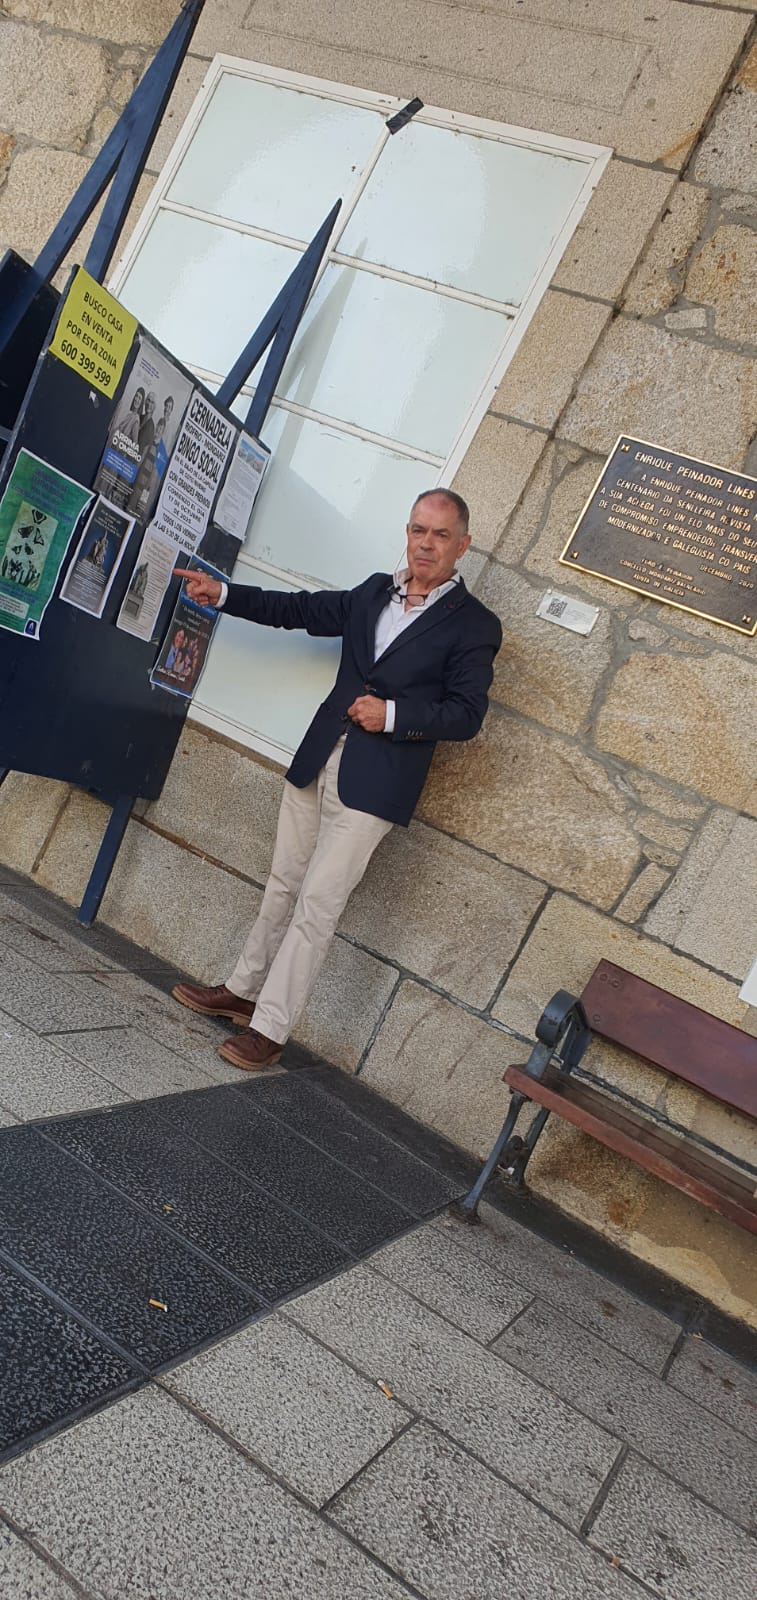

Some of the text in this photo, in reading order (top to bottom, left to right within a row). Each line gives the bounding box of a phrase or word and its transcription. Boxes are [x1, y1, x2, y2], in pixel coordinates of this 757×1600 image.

[82, 311, 113, 345] EN VENTA
[84, 292, 123, 333] BUSCO CASA
[61, 340, 111, 386] 600 399 599
[67, 320, 117, 369] POR ESTA ZONA
[114, 430, 139, 451] ARRIMA
[190, 398, 231, 450] CERNADELA
[119, 442, 141, 462] OMBRO
[178, 433, 200, 464] BINGO
[198, 450, 221, 483] SOCIAL
[168, 486, 190, 506] COMIENZO
[635, 452, 756, 500] ENRIQUE PEINADOR LINES
[599, 500, 608, 509] DE
[612, 503, 659, 526] COMPROMISO
[609, 489, 622, 500] SUA
[659, 505, 670, 517] FOI
[674, 513, 685, 522] UN
[688, 518, 702, 528] ELO
[705, 524, 725, 537] MAIS
[728, 531, 740, 542] DO
[617, 479, 660, 499] CENTENARIO
[664, 495, 673, 504] DA
[677, 500, 716, 519] SENLLEIRA
[651, 477, 682, 494] ENRIQUE
[686, 489, 723, 507] PEINADOR
[727, 503, 749, 517] LINES
[607, 516, 751, 574] MODERNIZADOR E GALEGUISTA CO PAIS
[620, 560, 647, 572] CONCELLO
[633, 574, 650, 583] XUNTA
[663, 585, 685, 596] GALICIA
[700, 564, 732, 580] DECEMBRO
